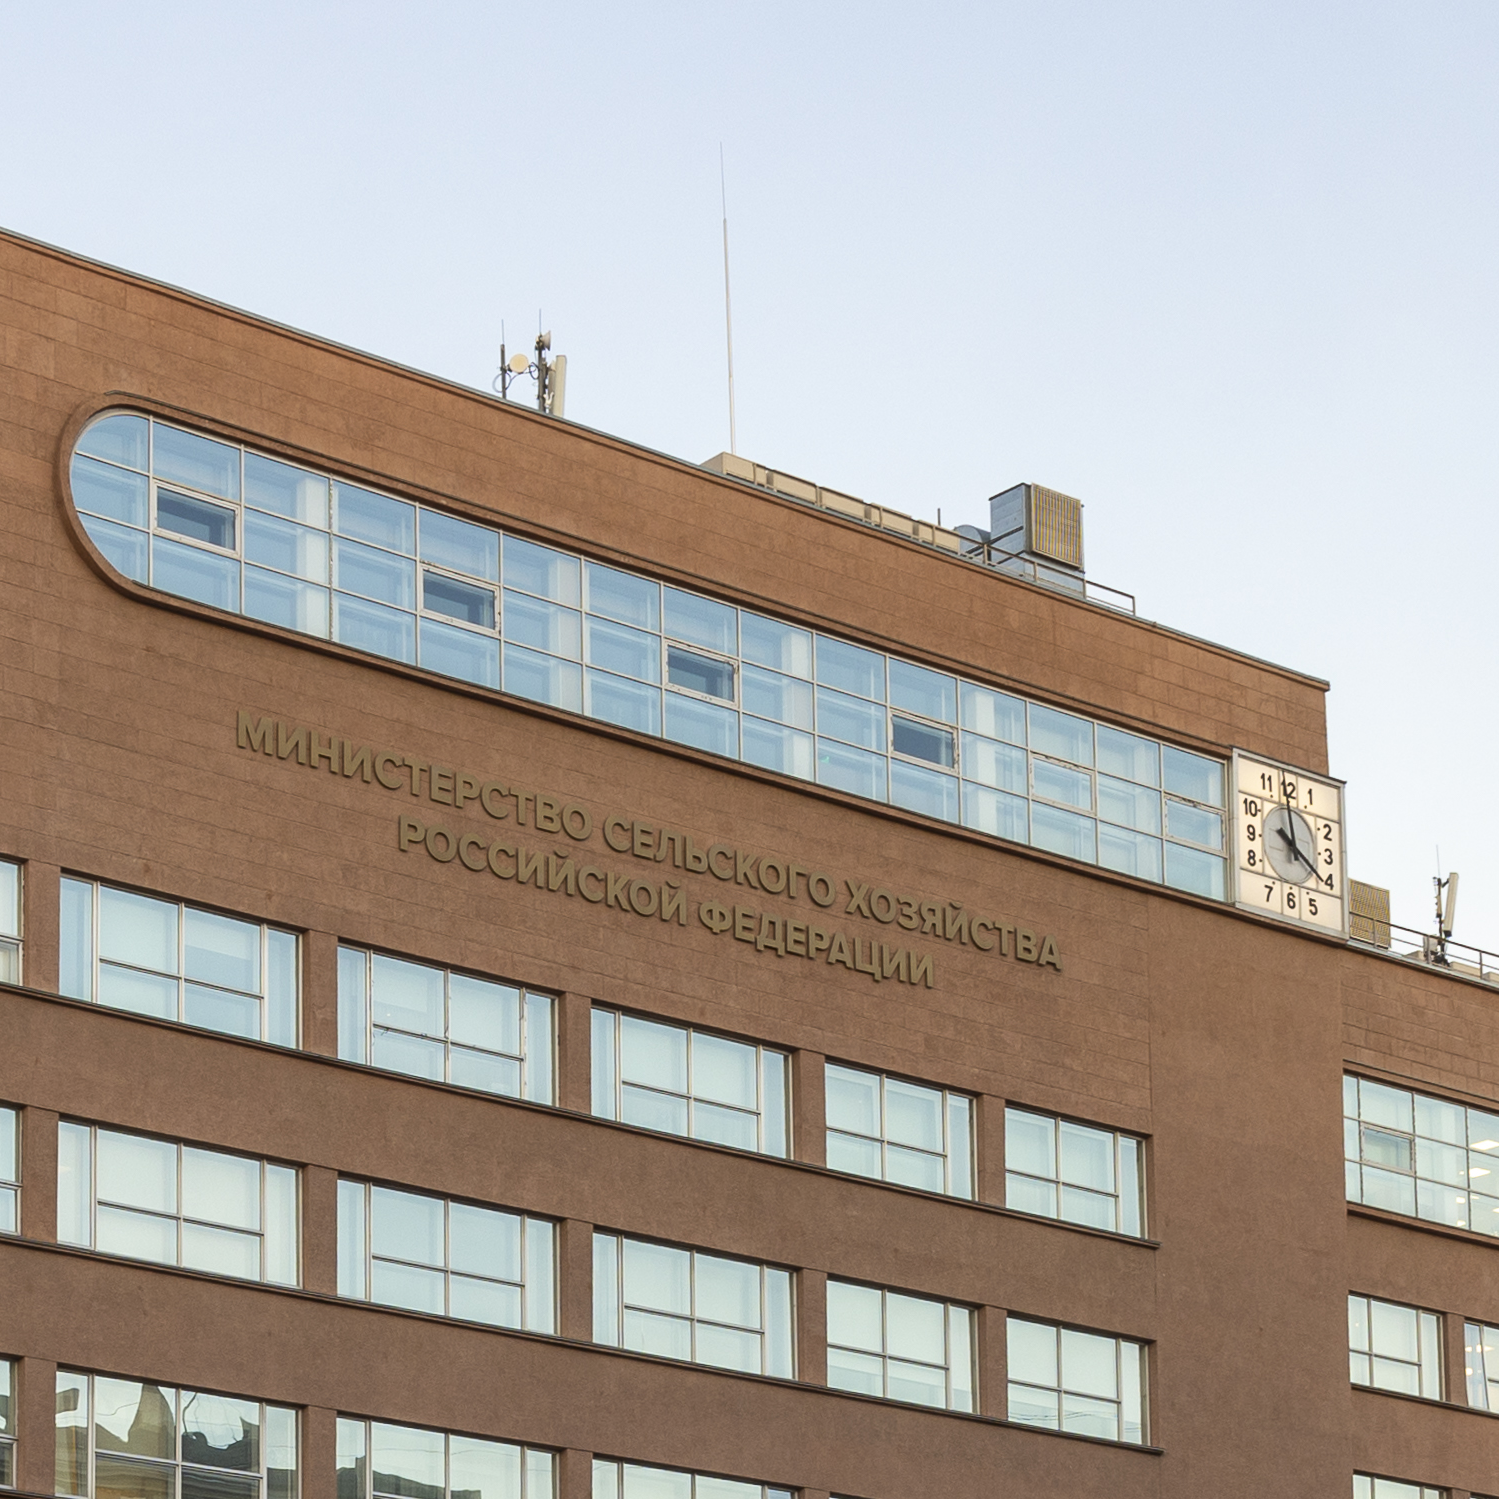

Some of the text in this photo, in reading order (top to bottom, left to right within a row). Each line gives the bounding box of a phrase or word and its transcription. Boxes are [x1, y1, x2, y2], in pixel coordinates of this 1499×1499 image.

[1260, 773, 1272, 792] 11
[1281, 779, 1296, 800] 12
[1243, 798, 1258, 817] 10
[237, 711, 1063, 970] МИНИСТЕРСТВО СЕЛЬСКОГО ХОЗЯЙСТВА
[1247, 824, 1256, 841] 9
[1323, 824, 1332, 842] 2
[1247, 849, 1256, 867] 8
[1324, 848, 1333, 866] 3
[1324, 874, 1334, 891] 4
[399, 815, 935, 988] РОССИЙСКОЙ ФЕДЕРАЦИИ
[1264, 884, 1273, 902] 7
[1287, 892, 1296, 909] 6
[1309, 898, 1318, 916] 5
